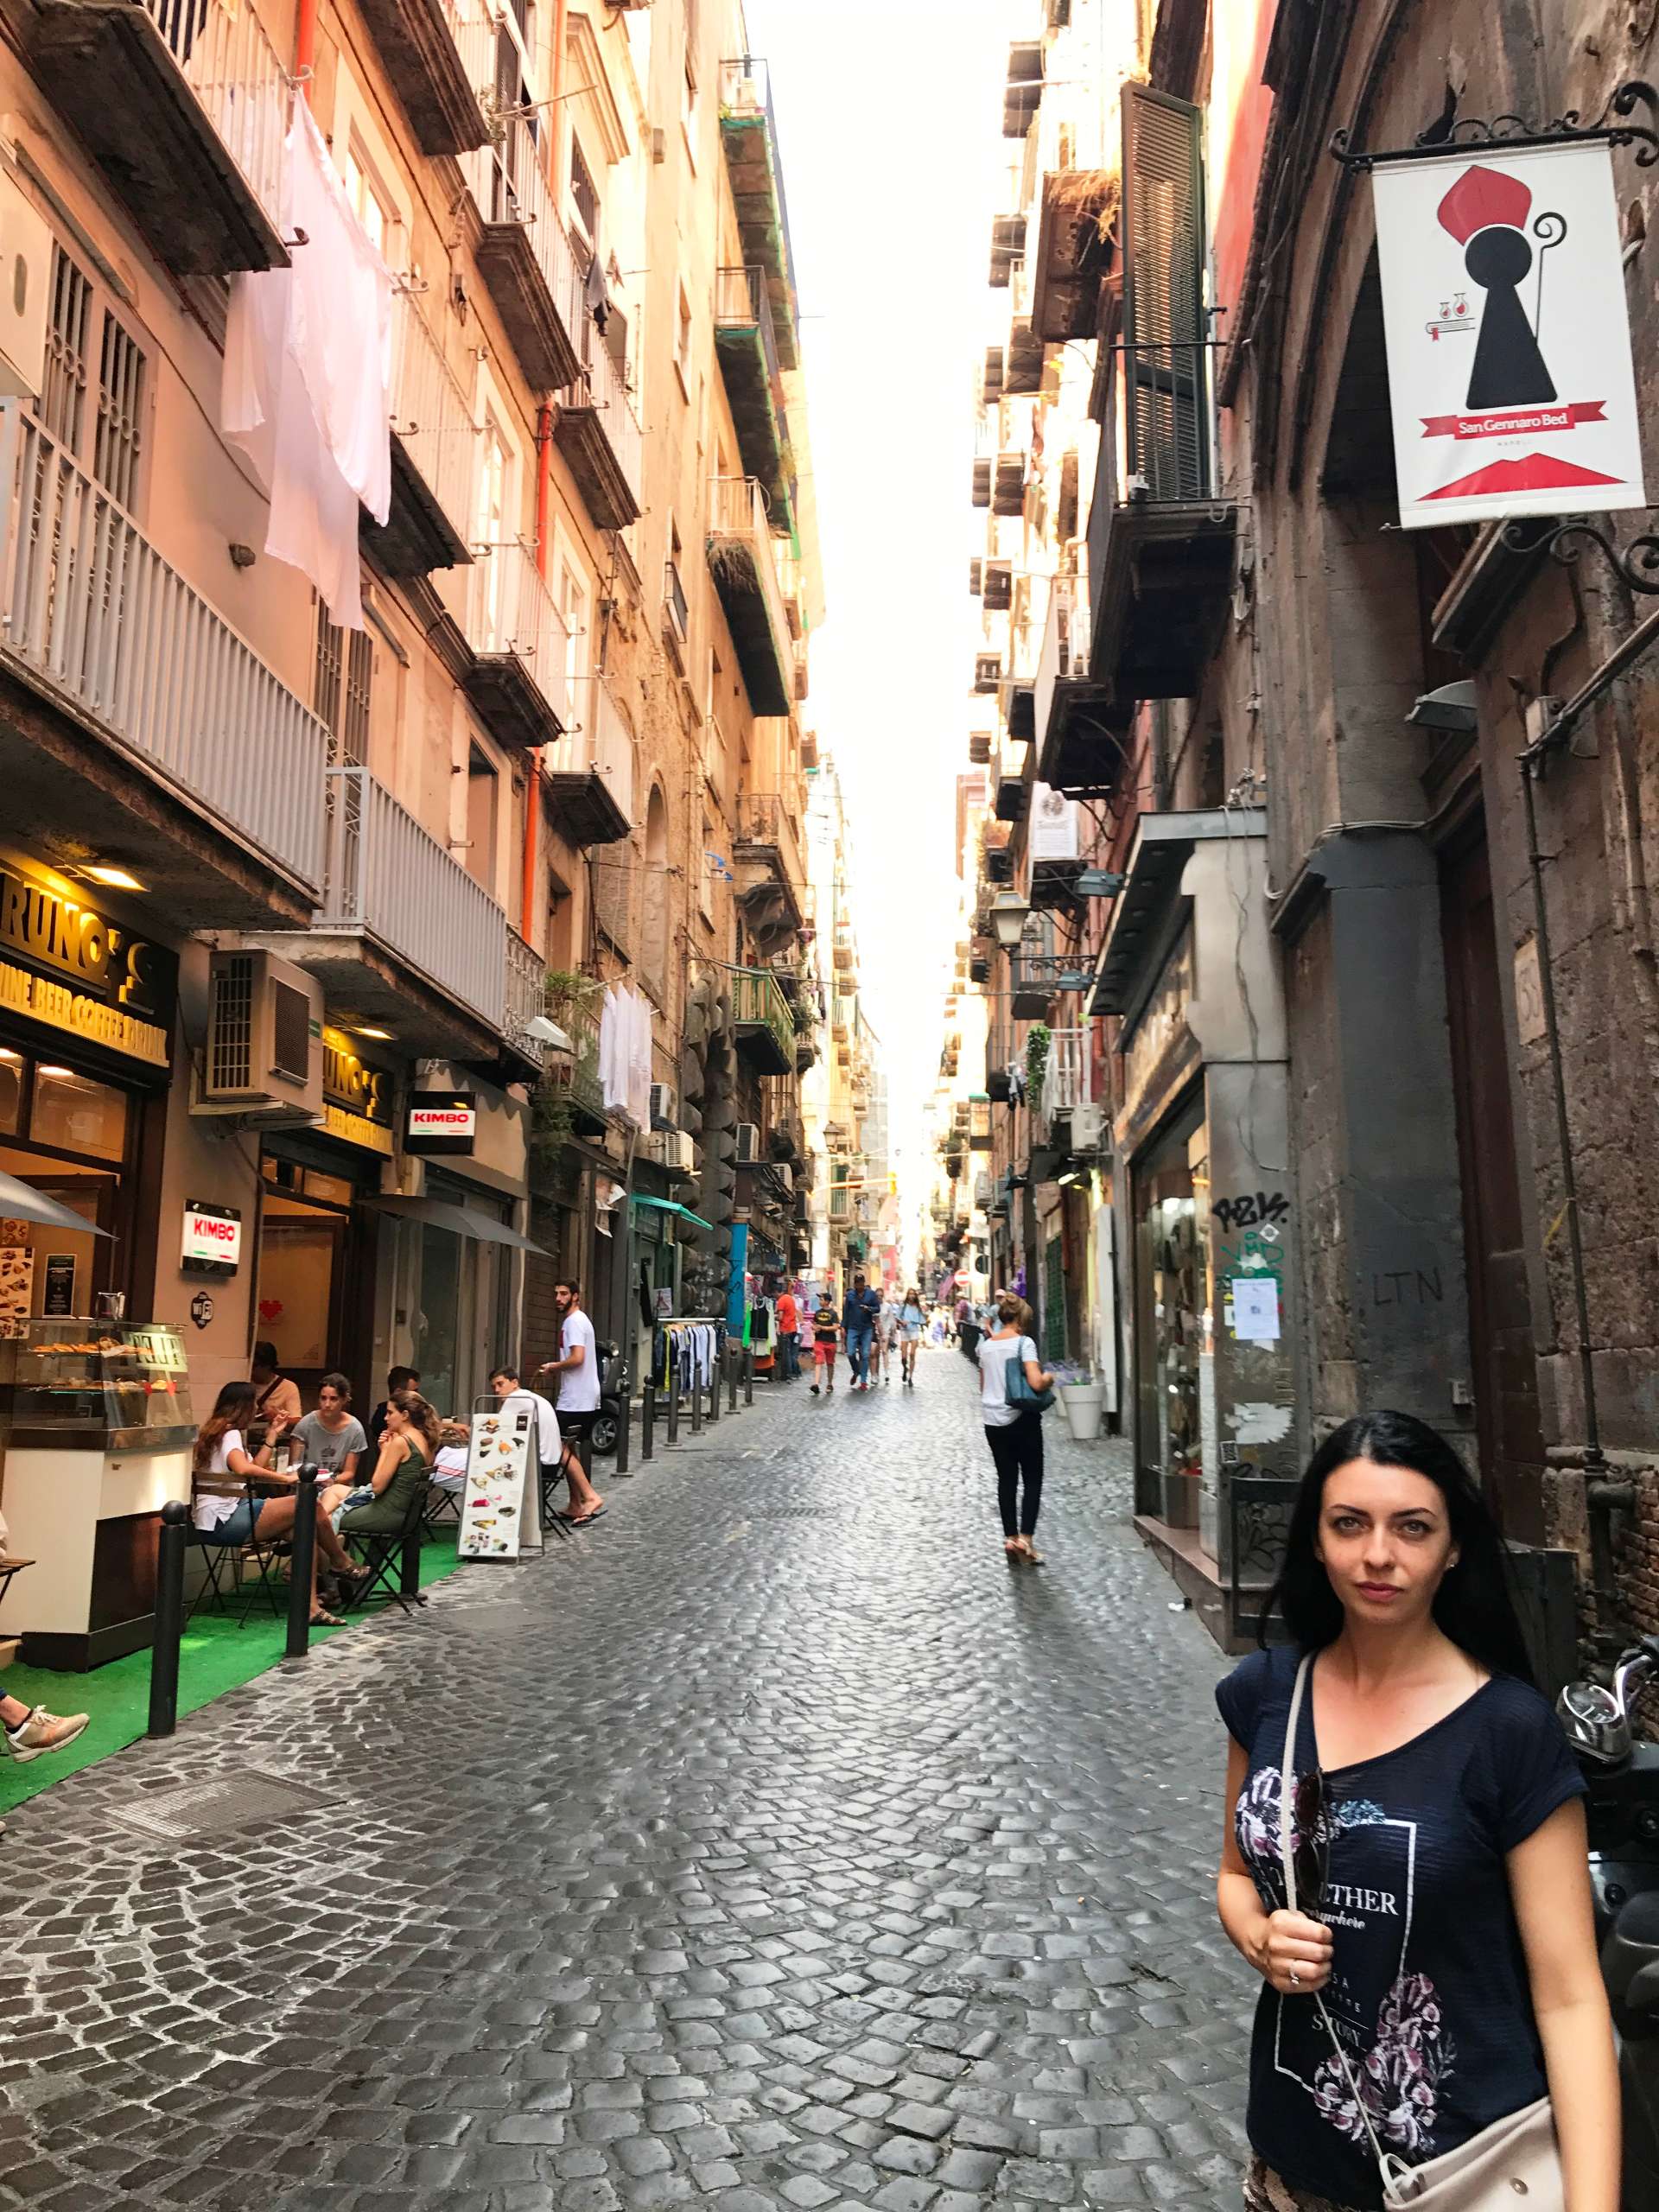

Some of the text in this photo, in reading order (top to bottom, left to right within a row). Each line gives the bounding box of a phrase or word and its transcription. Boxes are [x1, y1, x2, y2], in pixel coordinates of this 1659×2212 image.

[1459, 412, 1568, 435] San Gennaro Bed
[32, 976, 73, 1027] BEER
[414, 1113, 469, 1123] KIMBO
[194, 1217, 236, 1242] KIMBO
